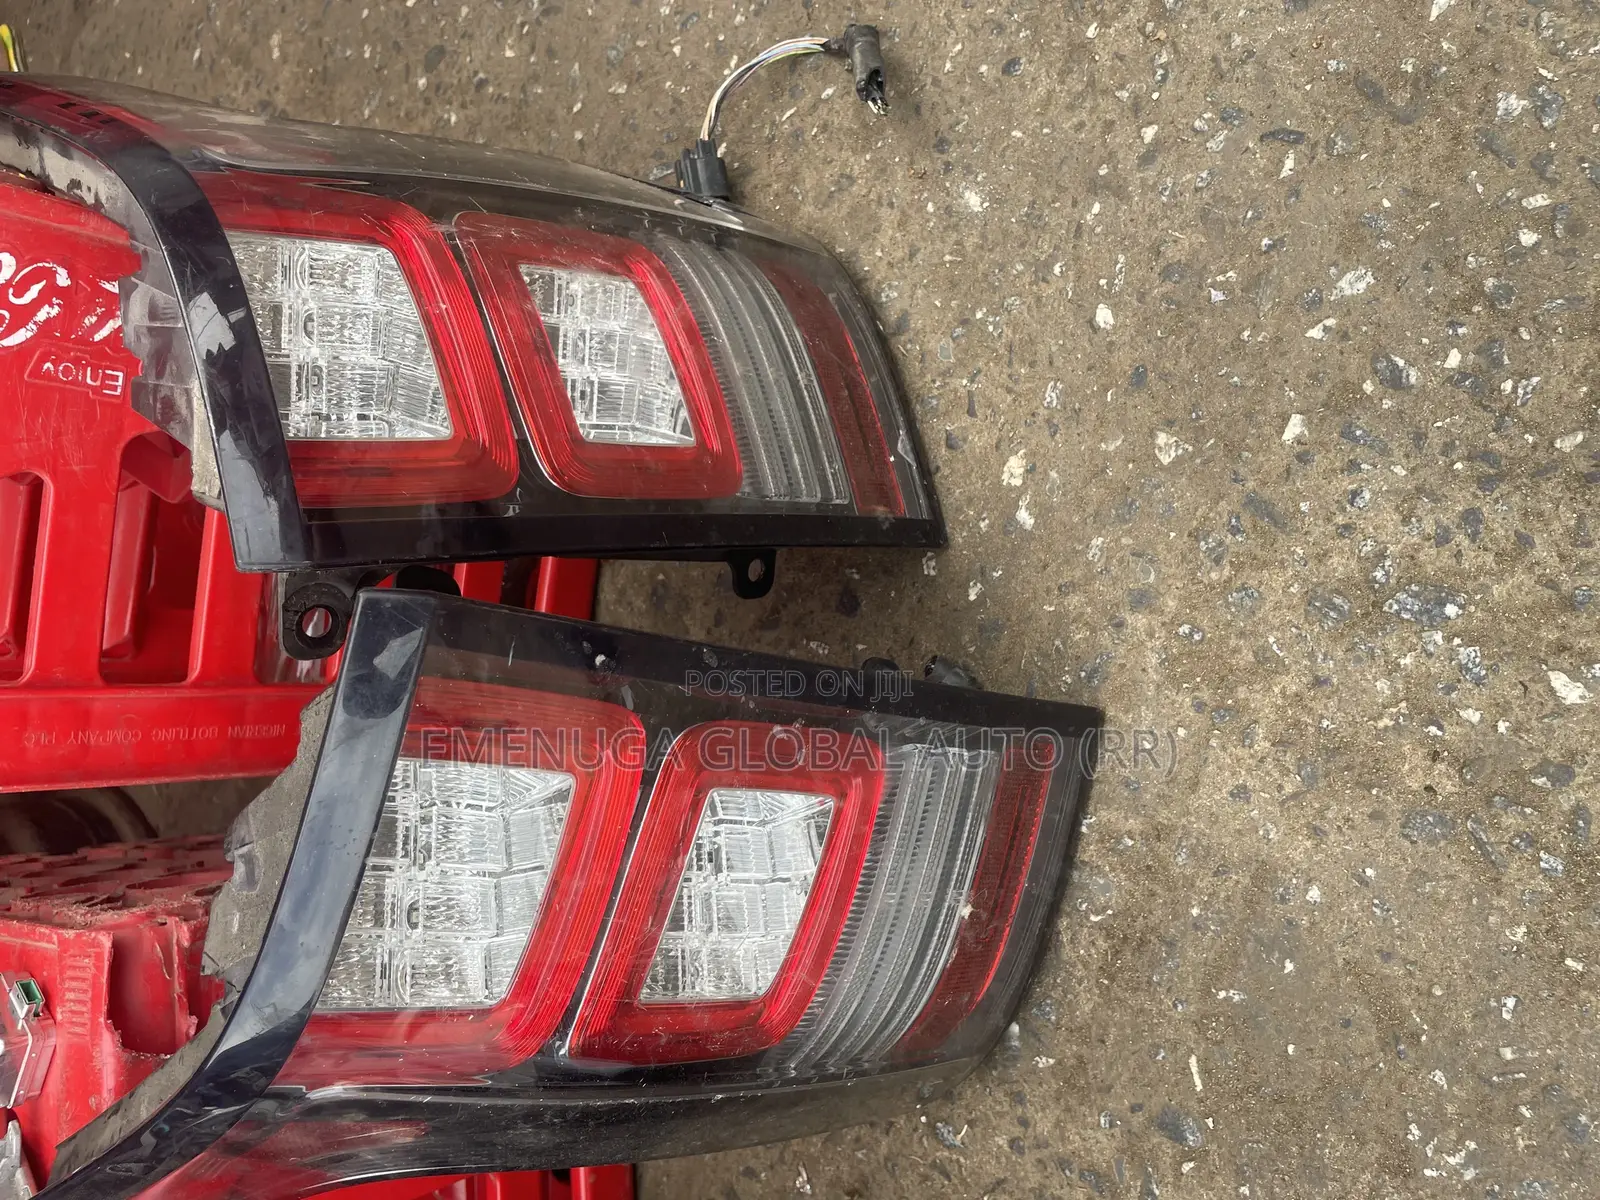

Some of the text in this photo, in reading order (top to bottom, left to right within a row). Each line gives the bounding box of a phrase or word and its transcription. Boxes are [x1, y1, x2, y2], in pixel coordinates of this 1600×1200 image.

[23, 723, 286, 746] NIGERIAN BOTTLING COMPANY PLC
